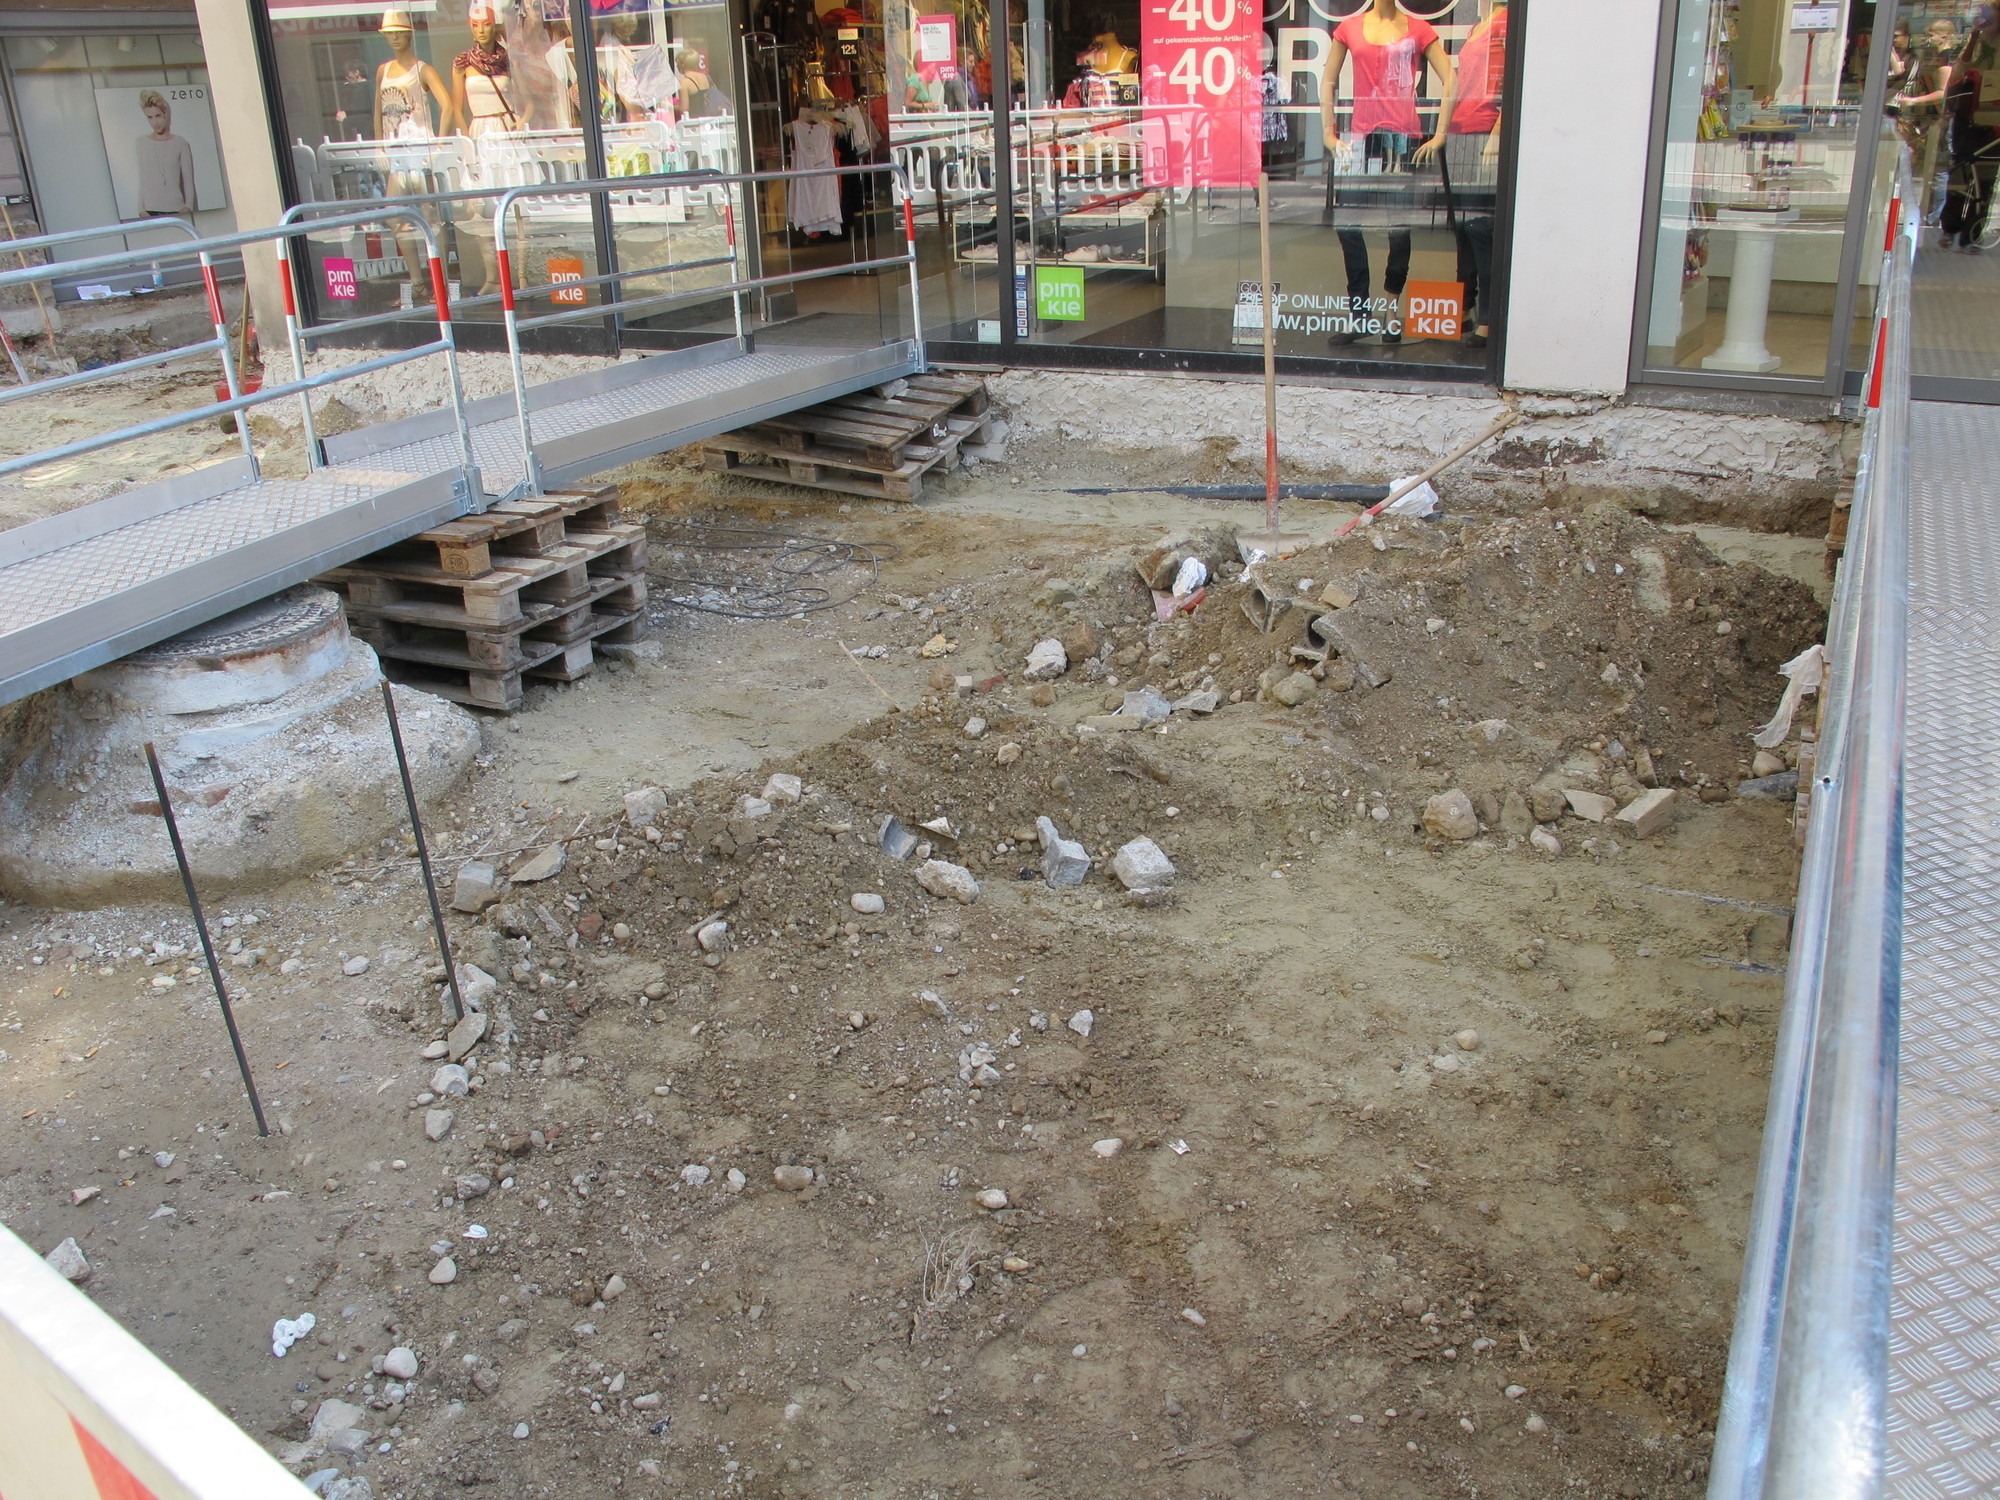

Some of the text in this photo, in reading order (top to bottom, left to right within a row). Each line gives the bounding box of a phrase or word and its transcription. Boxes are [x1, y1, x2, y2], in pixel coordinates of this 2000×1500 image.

[1165, 36, 1222, 45] gekennzeichnete
[1152, 46, 1252, 96] -40%
[170, 89, 204, 100] zero
[327, 270, 354, 287] pim
[551, 272, 582, 285] pim
[334, 284, 356, 297] kie
[558, 287, 583, 302] kie
[1040, 282, 1080, 301] pim
[1048, 301, 1081, 317] kie
[1292, 294, 1350, 310] ONLINE
[1410, 297, 1457, 319] pim
